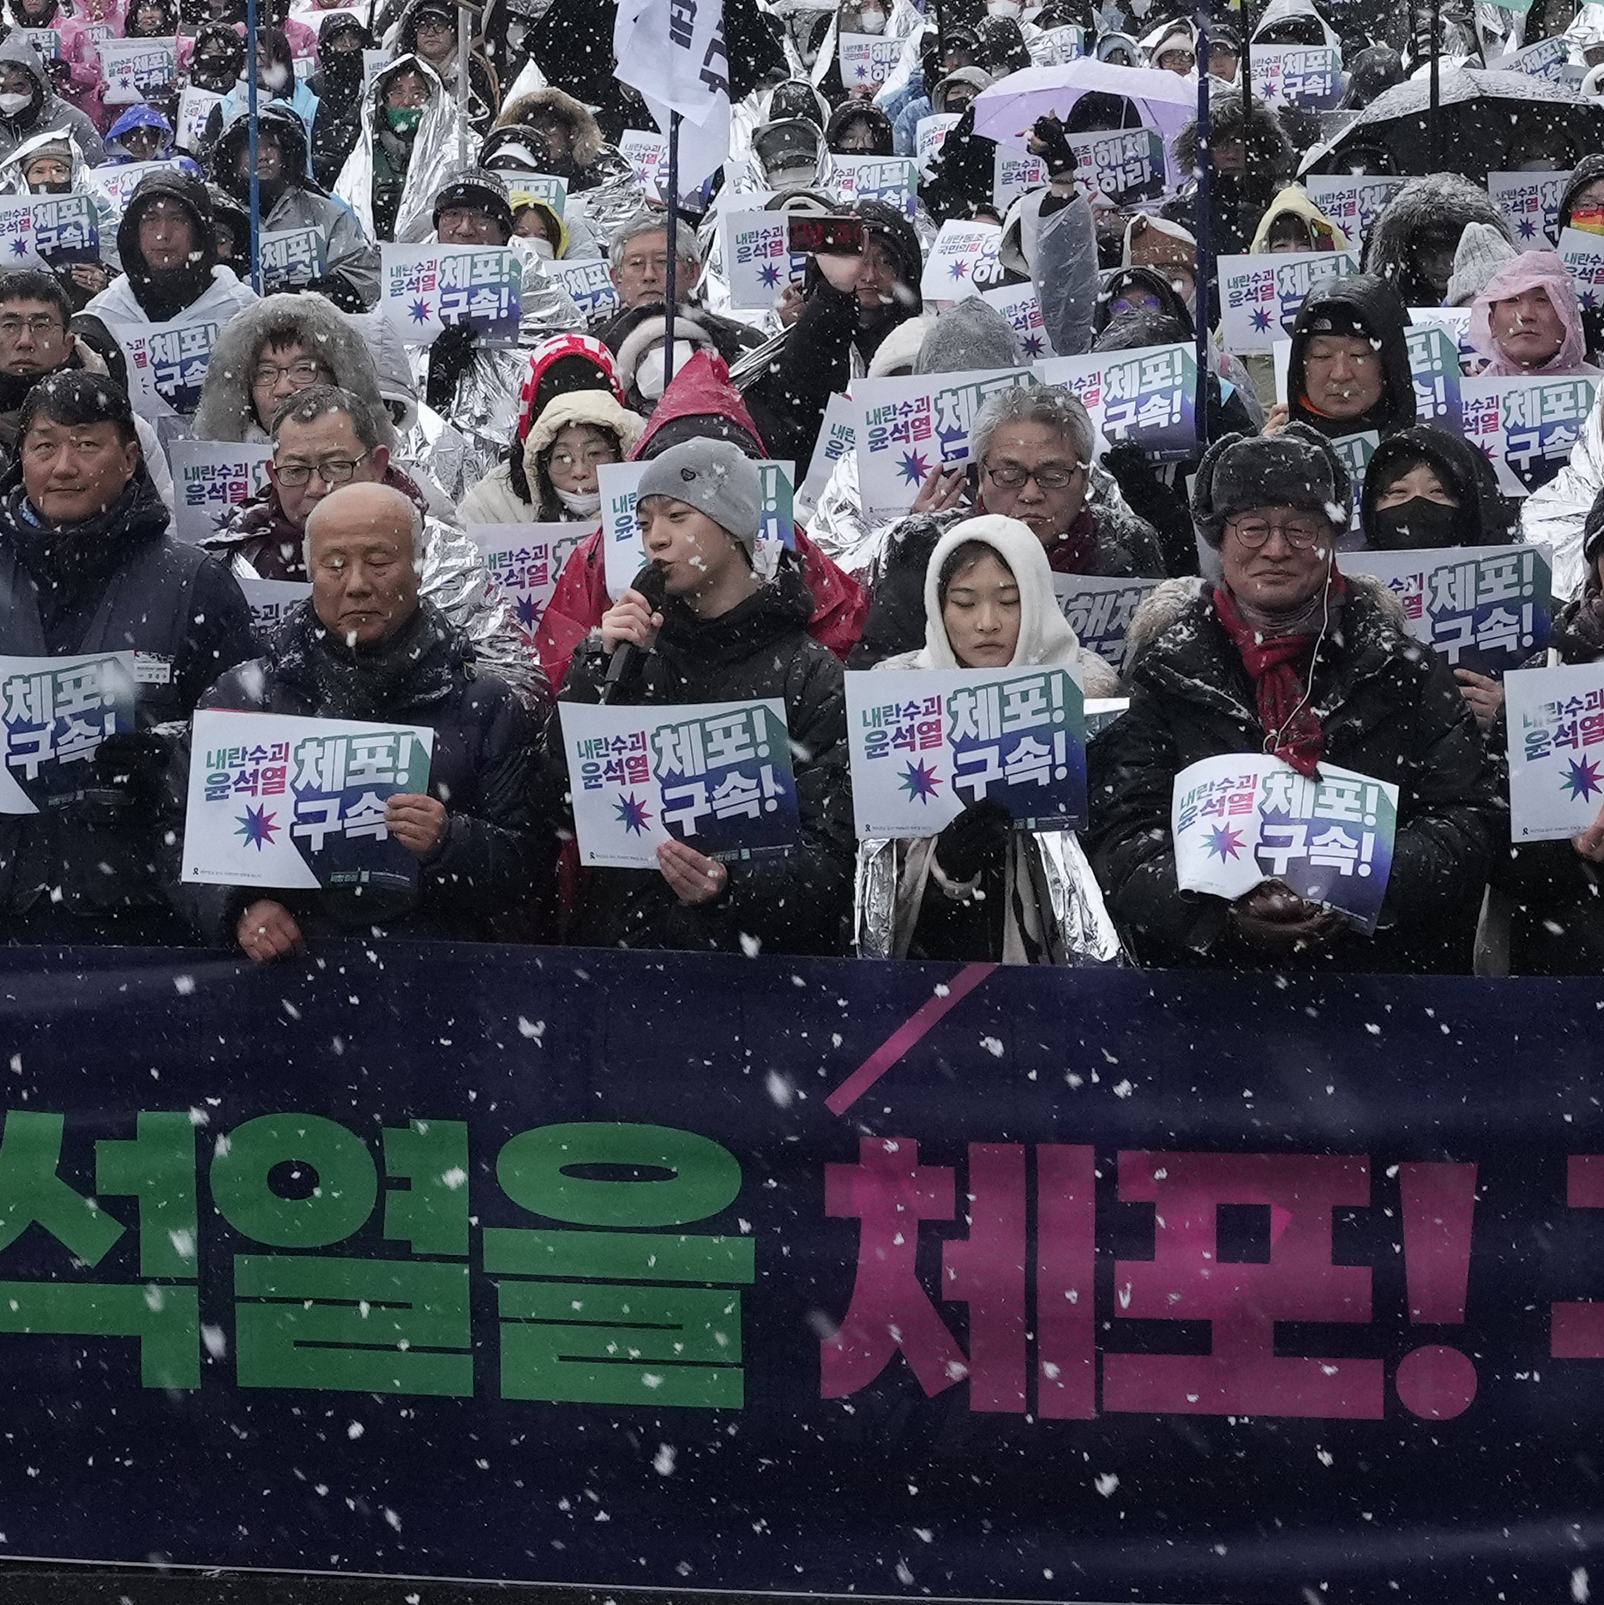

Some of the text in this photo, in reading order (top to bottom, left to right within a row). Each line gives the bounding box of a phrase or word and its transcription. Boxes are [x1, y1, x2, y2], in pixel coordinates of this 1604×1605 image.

[1096, 135, 1151, 167] 해체
[1099, 163, 1154, 195] 하라
[35, 197, 90, 227] 체포!
[37, 223, 90, 253] 구속!
[735, 228, 785, 249] 내란수괴
[736, 244, 785, 264] 윤석열
[389, 260, 437, 280] 내란수괴
[390, 275, 437, 298] 윤석열
[440, 250, 513, 291] 체포!
[1227, 268, 1275, 289] 내란수괴
[439, 287, 512, 324] 구속!
[1227, 282, 1275, 308] 윤석열
[1103, 353, 1184, 403] 체포!
[865, 397, 931, 425] 내란수괴
[1103, 400, 1182, 441] 구속!
[1504, 380, 1597, 426] 체포!
[867, 416, 933, 452] 윤석열
[183, 460, 249, 483] 내란수괴
[183, 482, 249, 506] 윤석열
[1431, 553, 1535, 611] 체포!
[1434, 606, 1535, 663] 구속!
[4, 662, 117, 724] 체포!
[862, 695, 942, 728] 내란수괴
[950, 672, 1065, 744] 체포!
[1522, 688, 1604, 728] 내란수괴
[205, 741, 289, 770] 내란수괴
[576, 730, 647, 760] 내란수괴
[652, 707, 770, 778] 체포!
[863, 721, 942, 759] 윤석열
[295, 732, 412, 794] 체포!
[580, 755, 649, 789] 윤석열
[955, 730, 1068, 799] 구속!
[204, 765, 288, 801] 윤석열
[661, 768, 778, 835] 구속!
[1179, 773, 1257, 811] 내란수괴
[1261, 773, 1377, 824] 체포!
[292, 790, 387, 850] 구속
[1178, 796, 1255, 833] 윤석열
[1257, 823, 1372, 876] 구속!
[822, 1138, 1477, 1420] 체포!
